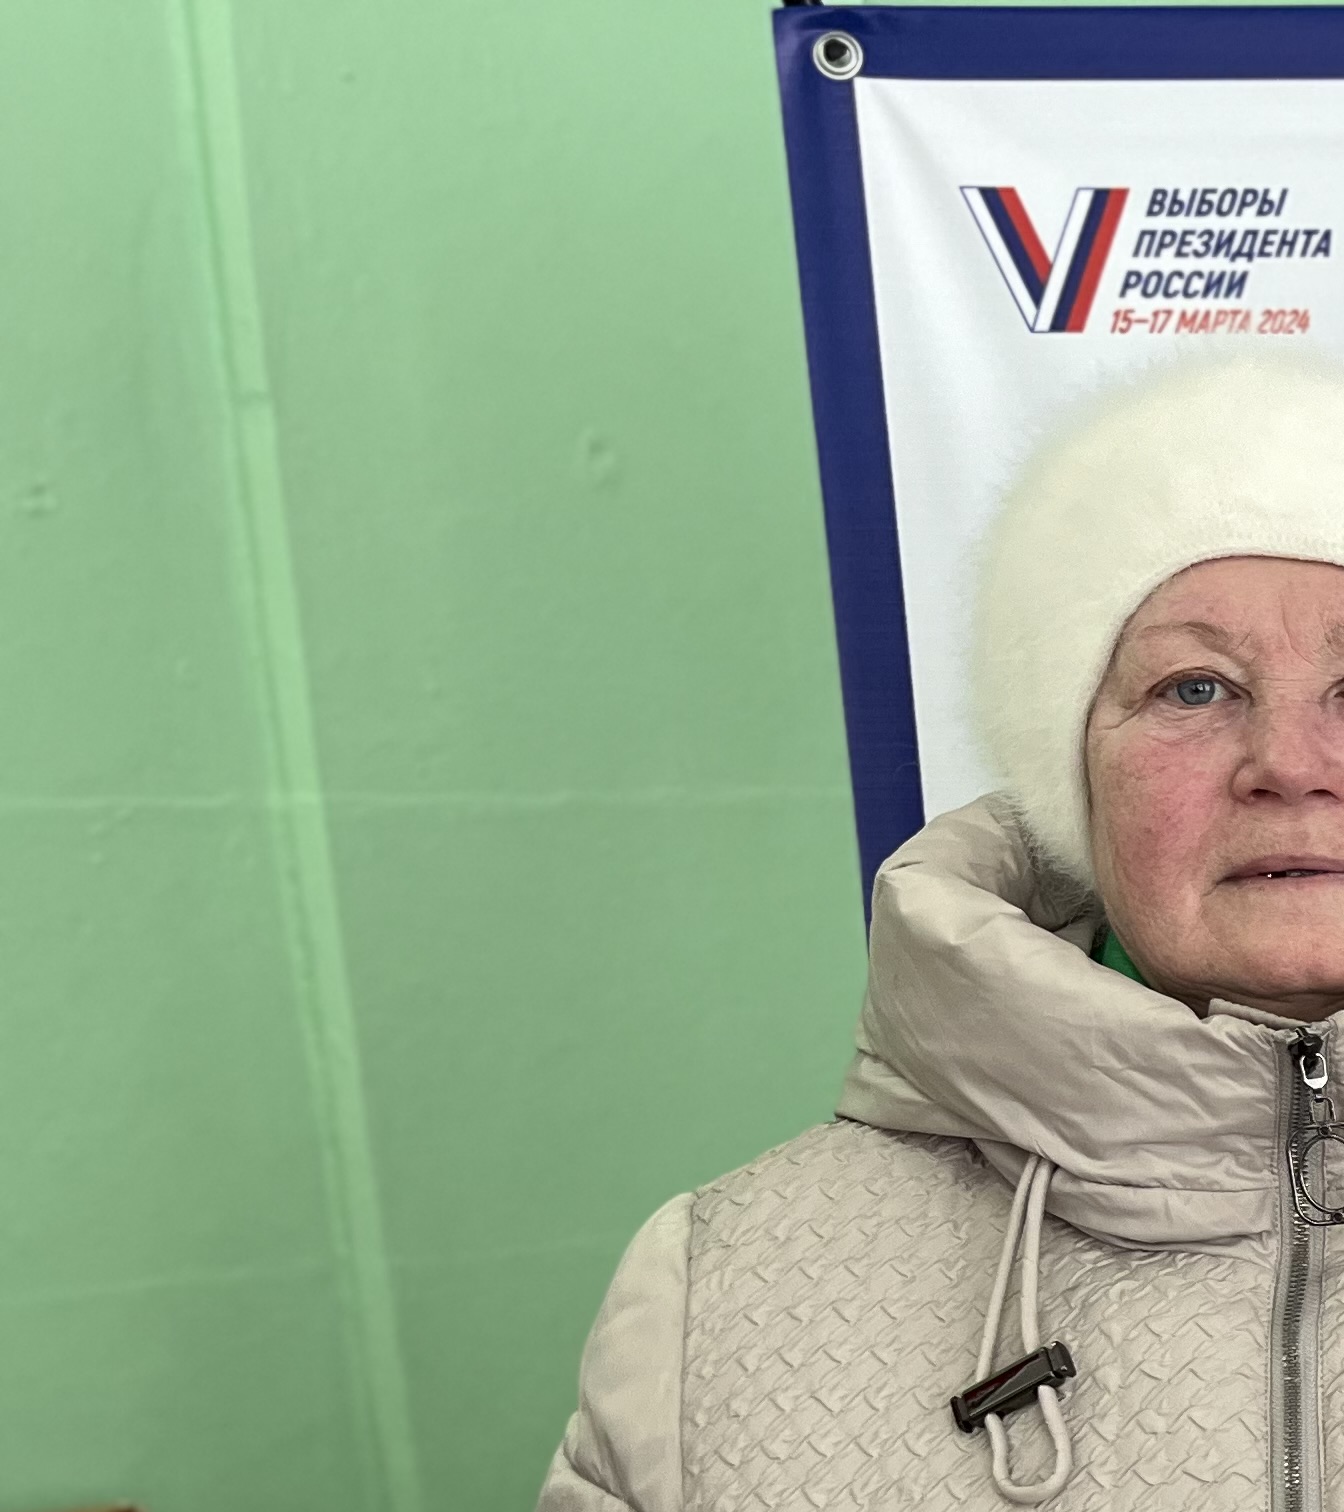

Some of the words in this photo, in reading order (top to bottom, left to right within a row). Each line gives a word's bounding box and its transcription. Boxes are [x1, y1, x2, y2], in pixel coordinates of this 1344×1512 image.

[1146, 188, 1288, 217] ВЫБОРЫ
[1132, 229, 1332, 261] ПРЕЗИДЕНТА
[1119, 270, 1249, 299] РОССИИ
[1175, 309, 1252, 334] МАРТА
[1257, 309, 1311, 334] 2024
